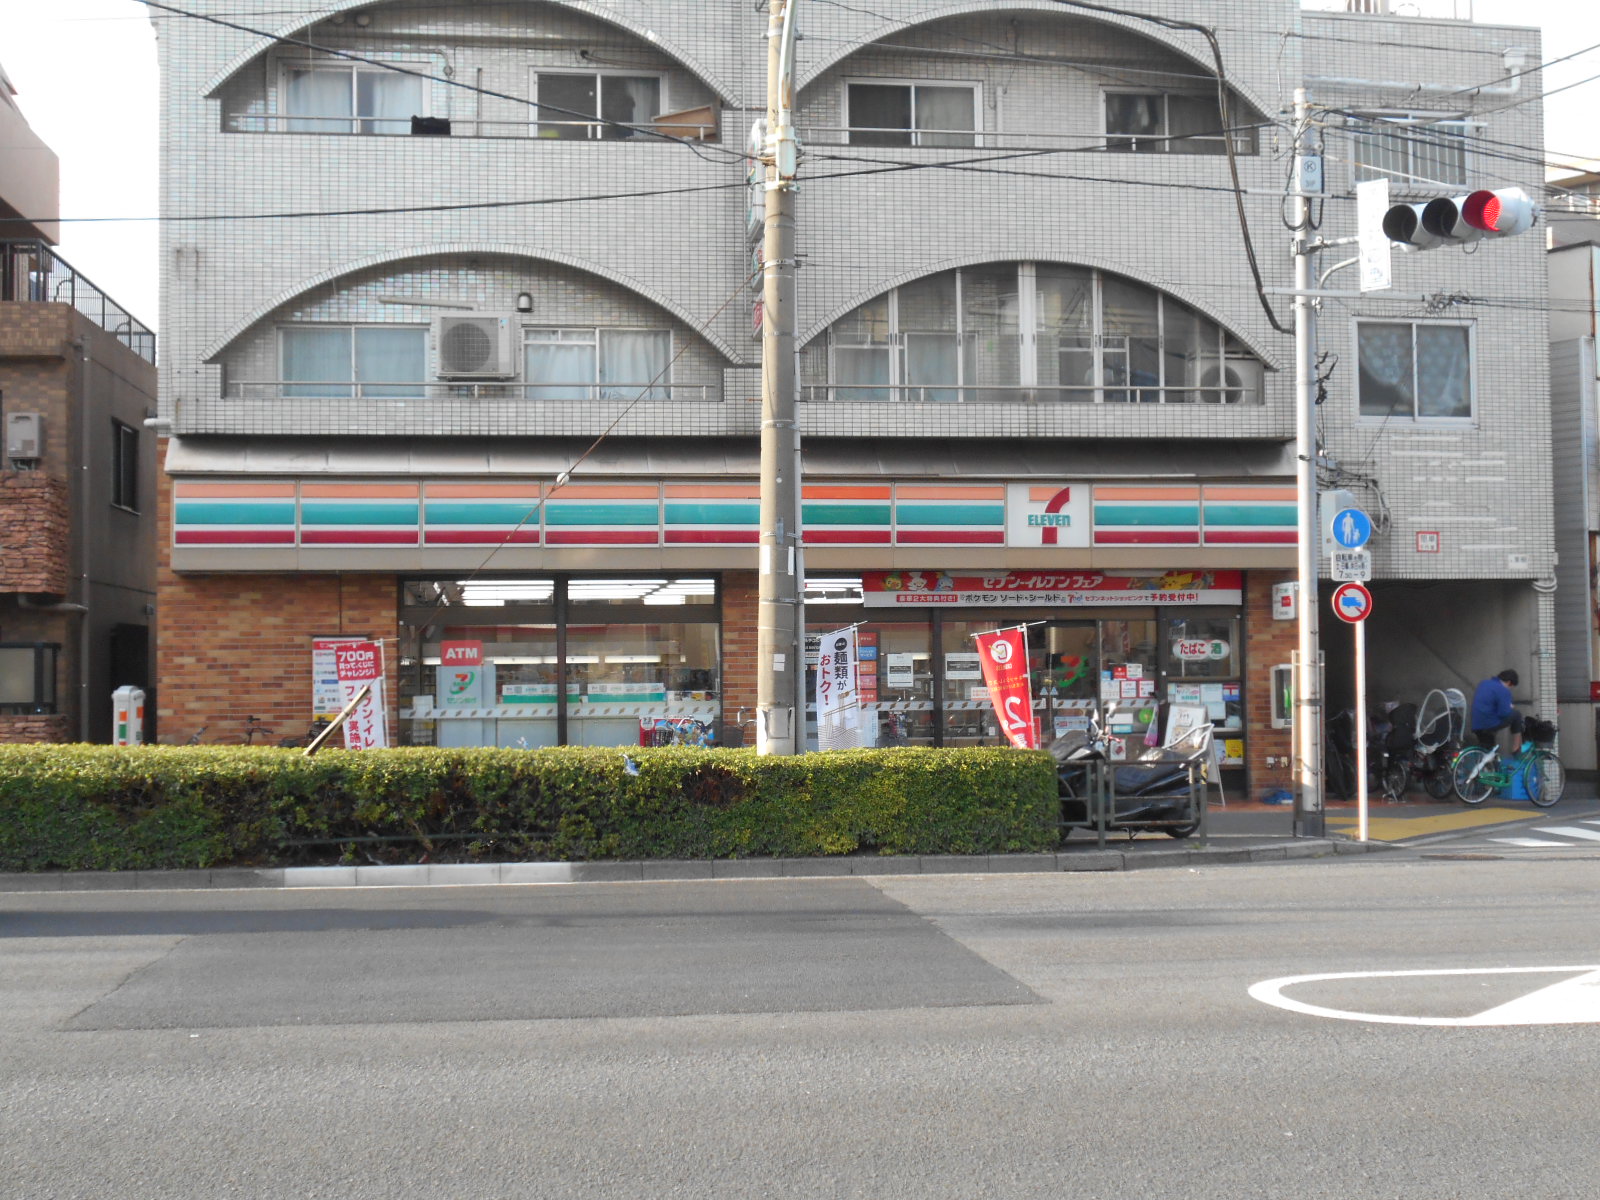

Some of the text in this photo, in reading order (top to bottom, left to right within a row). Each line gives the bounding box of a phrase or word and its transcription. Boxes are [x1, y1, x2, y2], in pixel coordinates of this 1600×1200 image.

[1072, 575, 1104, 588] フェア
[445, 647, 478, 659] ATM
[1180, 643, 1205, 655] たばこ
[337, 650, 374, 662] 700円
[834, 651, 848, 691] 麺類が
[820, 654, 832, 706] おトク!
